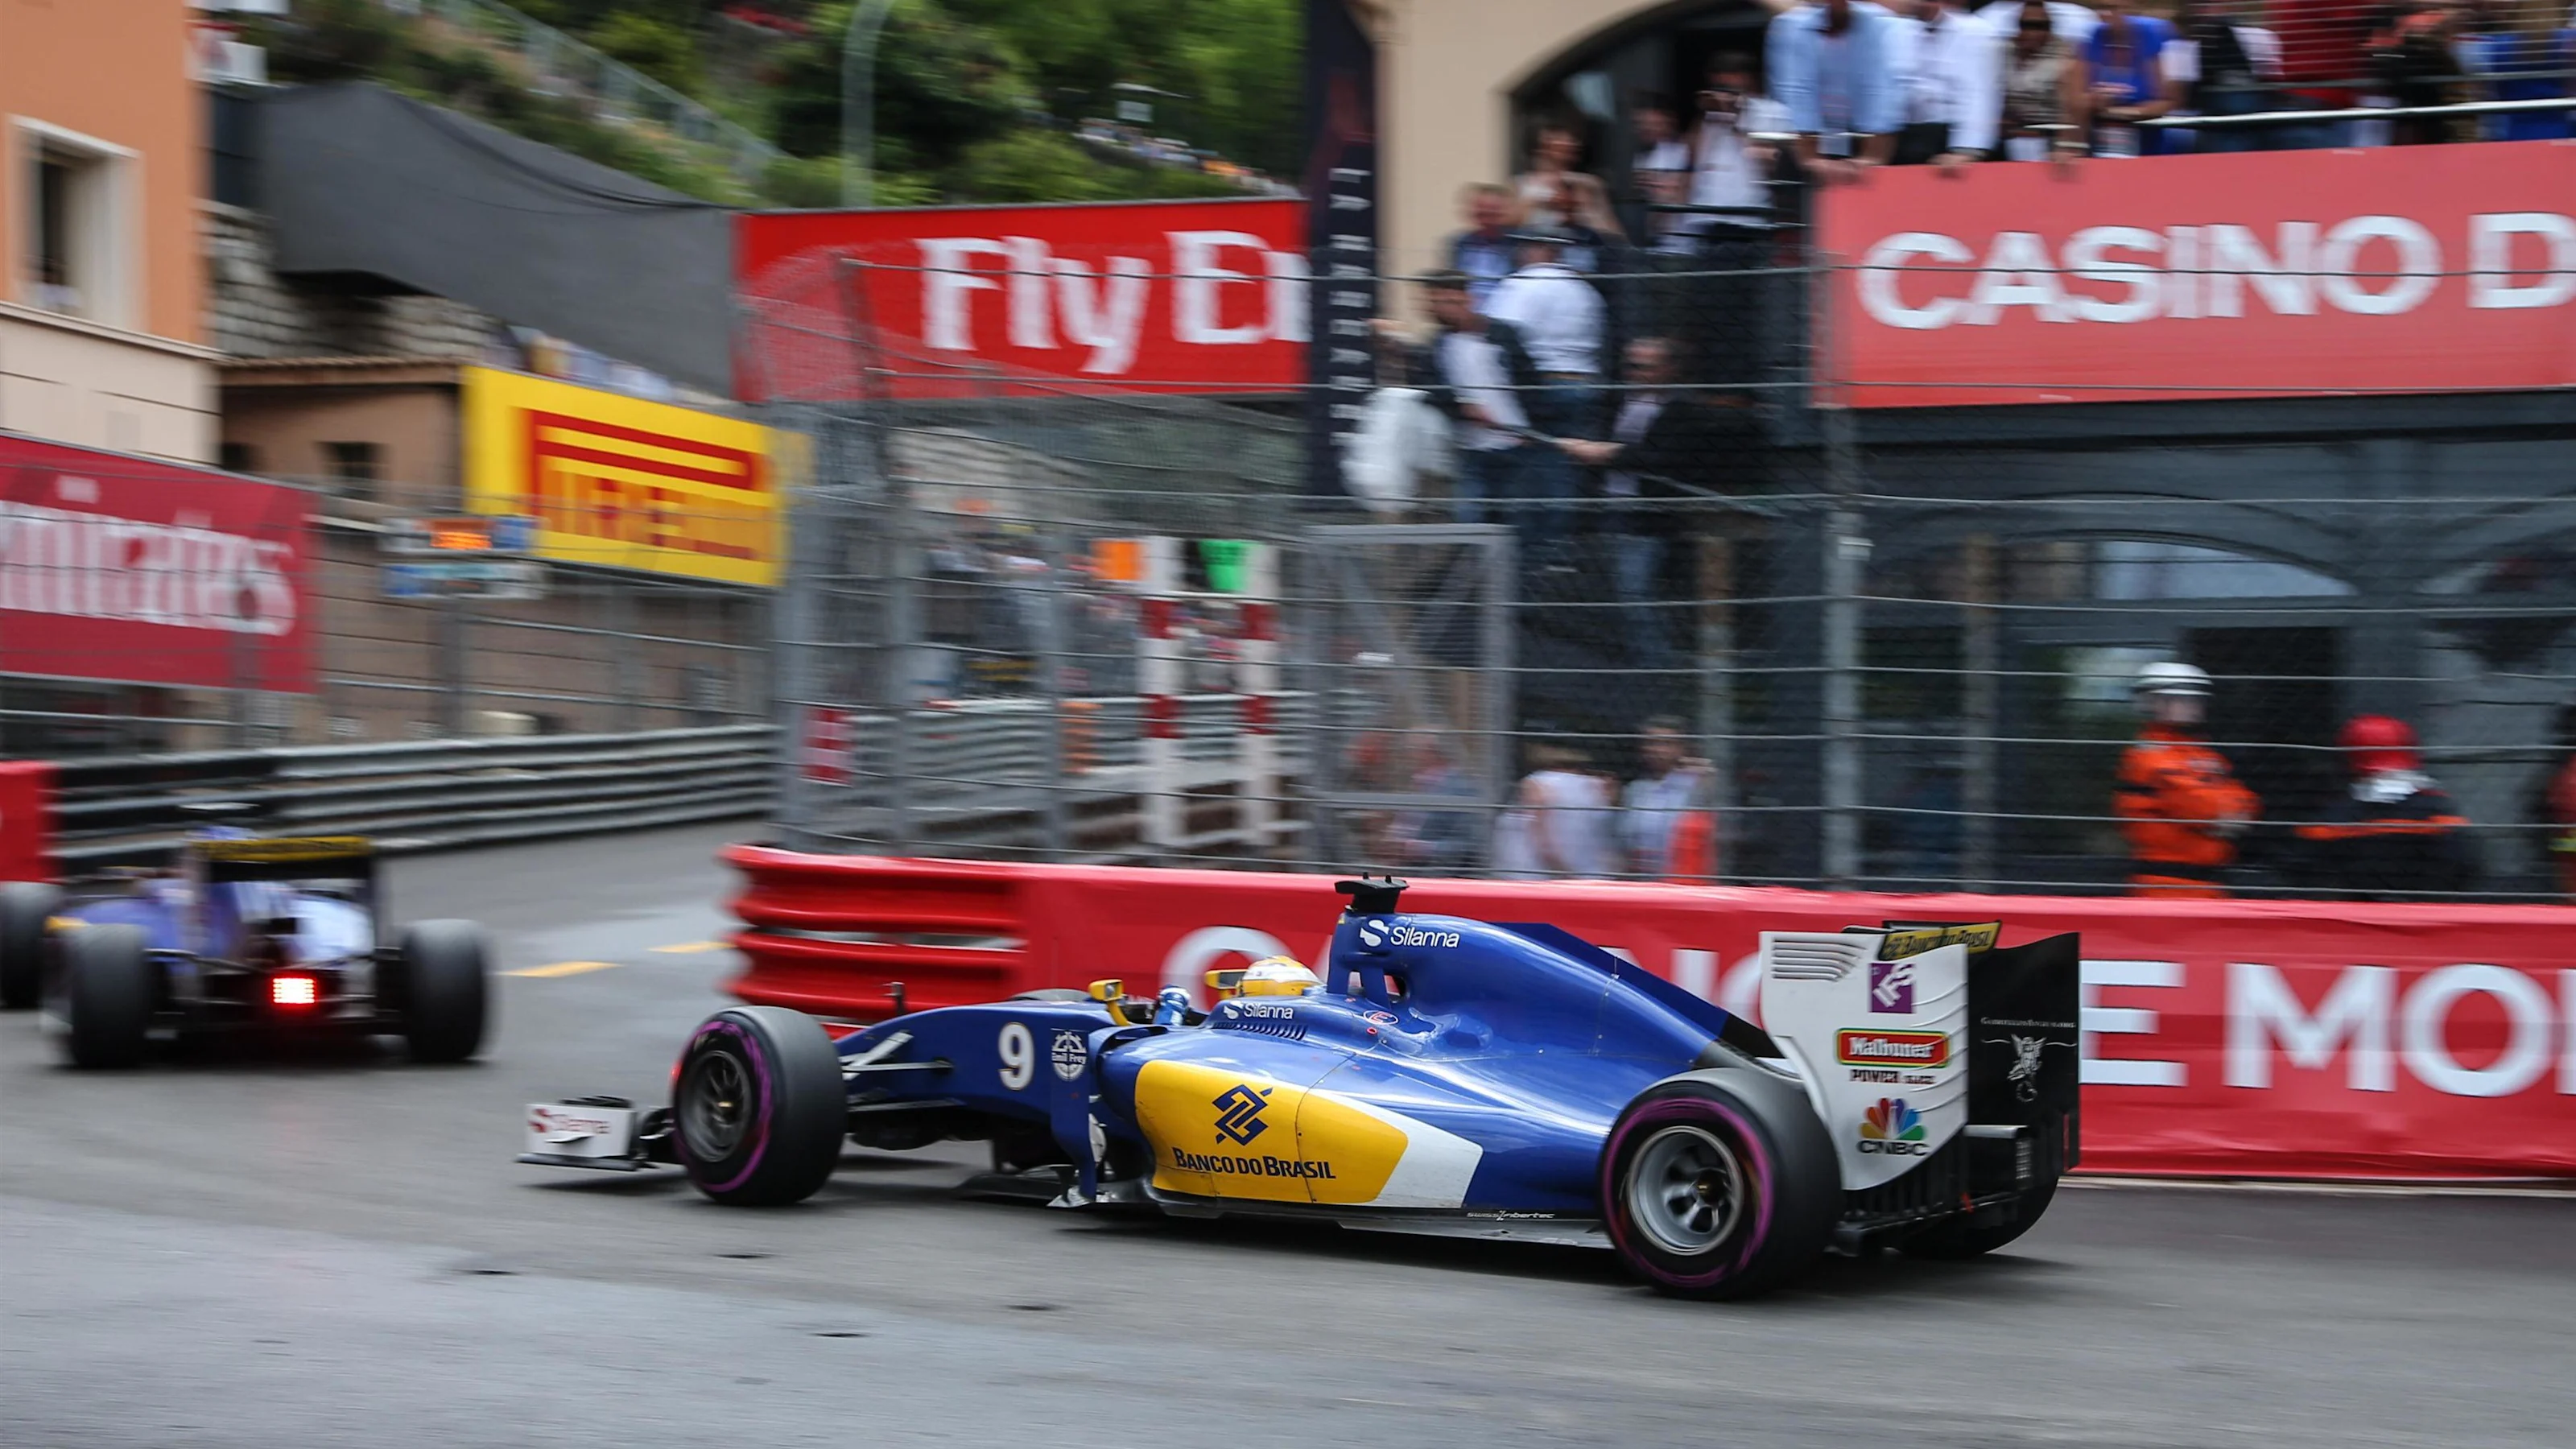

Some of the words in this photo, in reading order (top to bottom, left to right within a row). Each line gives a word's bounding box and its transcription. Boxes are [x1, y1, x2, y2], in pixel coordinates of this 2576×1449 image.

[1856, 215, 2444, 330] CASINO
[913, 235, 1153, 374] Fly
[1390, 926, 1460, 948] Silanna
[1244, 1002, 1294, 1020] Silanna
[997, 1022, 1035, 1091] 9
[1172, 1146, 1234, 1174] BANCO
[1235, 1157, 1262, 1176] DO
[1262, 1155, 1337, 1179] BRASIL
[1856, 1140, 1931, 1157] CNBC
